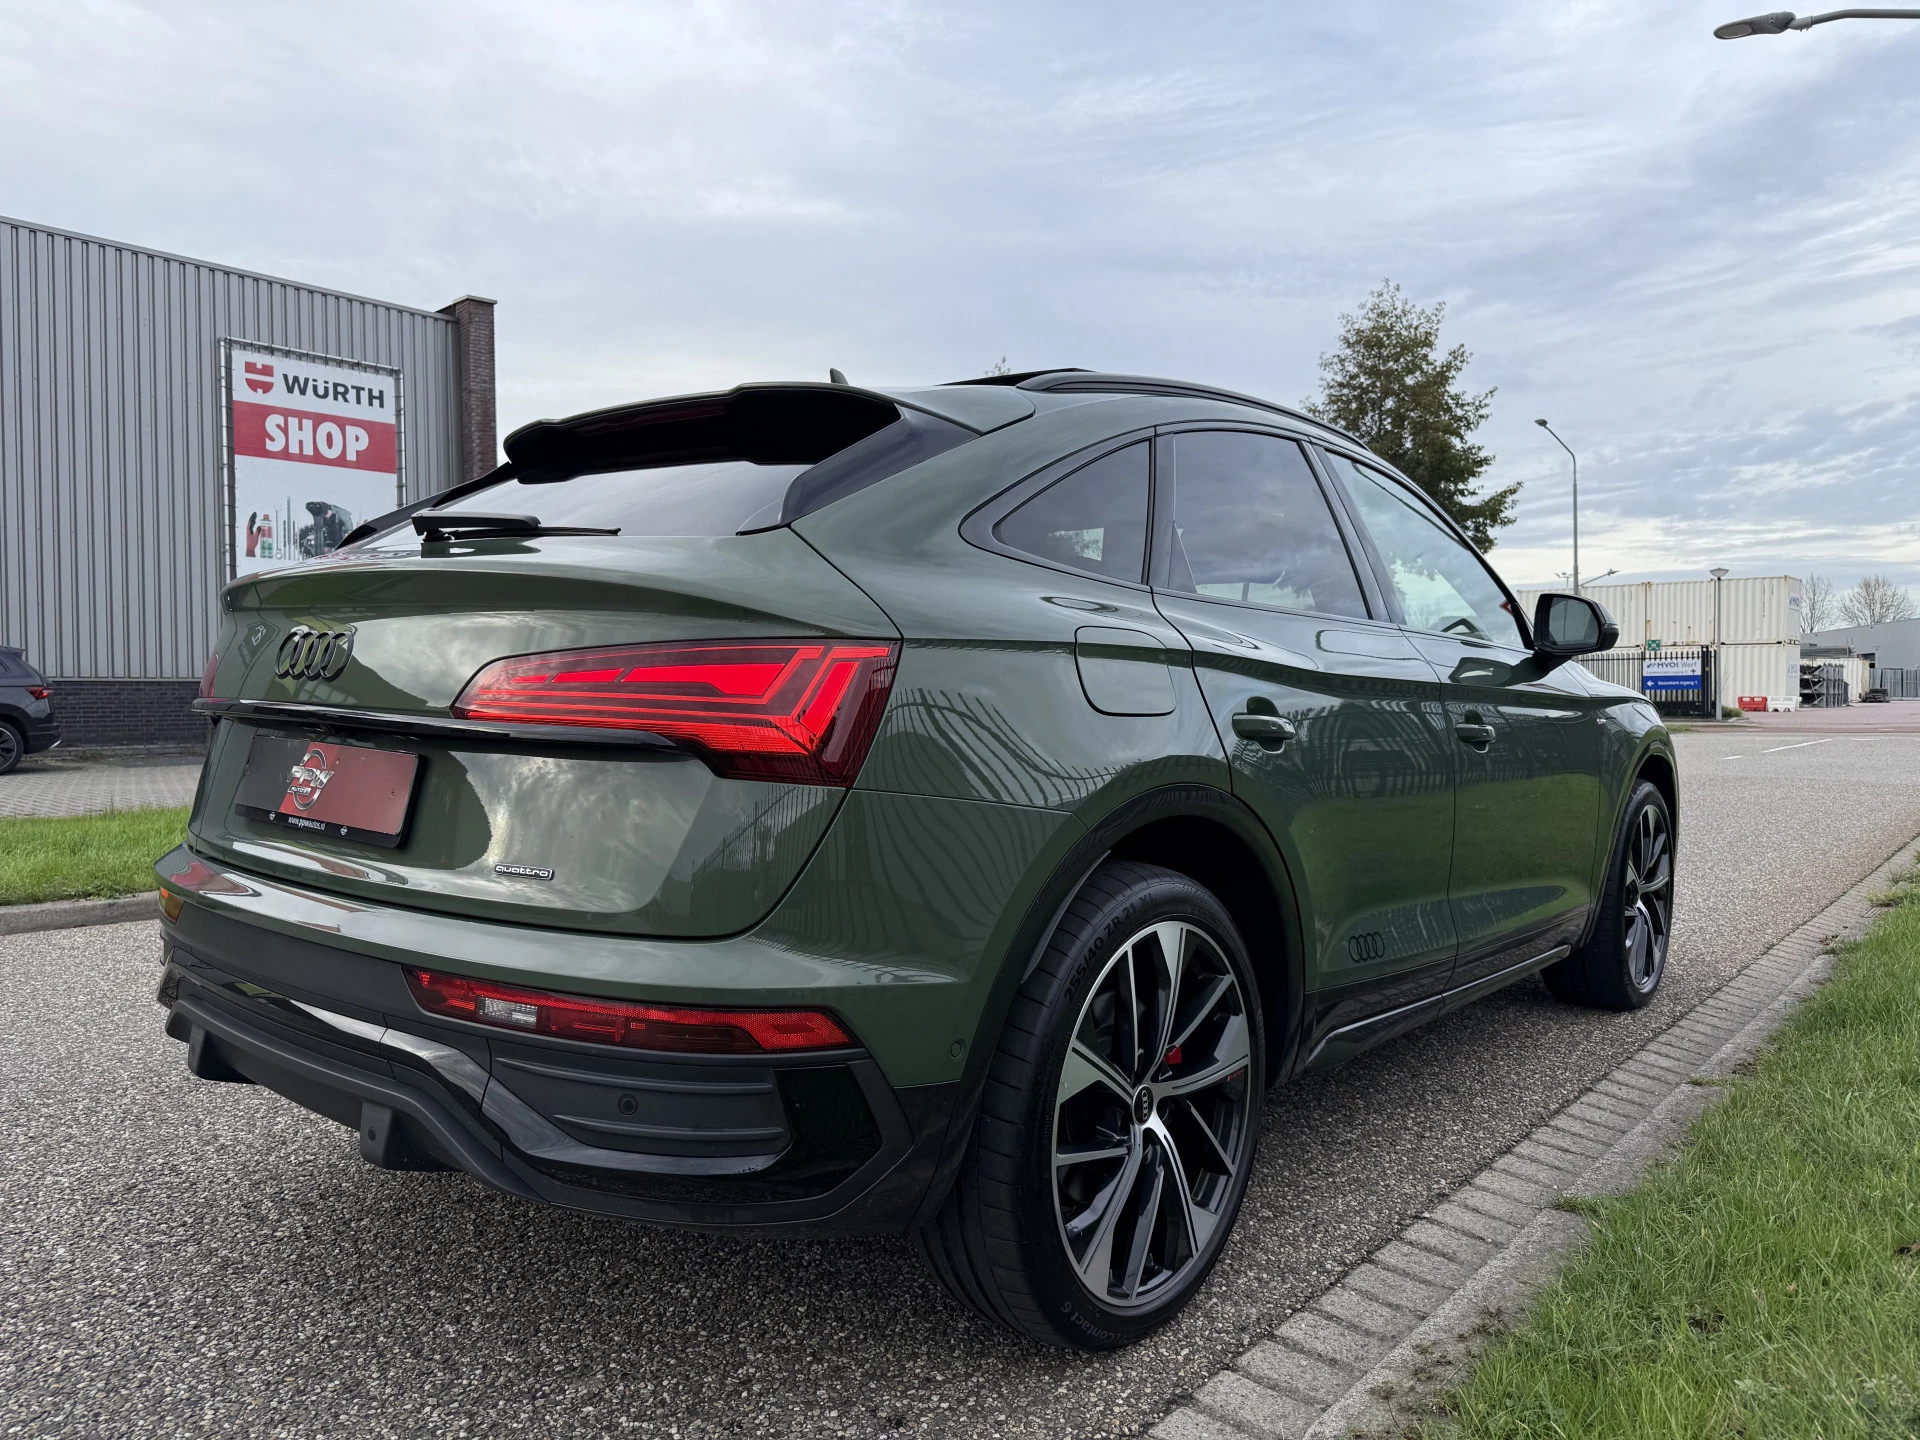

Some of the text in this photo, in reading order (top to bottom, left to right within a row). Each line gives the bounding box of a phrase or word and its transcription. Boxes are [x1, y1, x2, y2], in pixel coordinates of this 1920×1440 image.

[282, 373, 385, 409] WÜRTH
[264, 413, 369, 462] SHOP
[286, 765, 335, 789] PPW
[495, 865, 549, 877] quattro
[1064, 936, 1105, 1004] 255/40
[1103, 915, 1121, 939] ZR
[1122, 902, 1137, 920] 21
